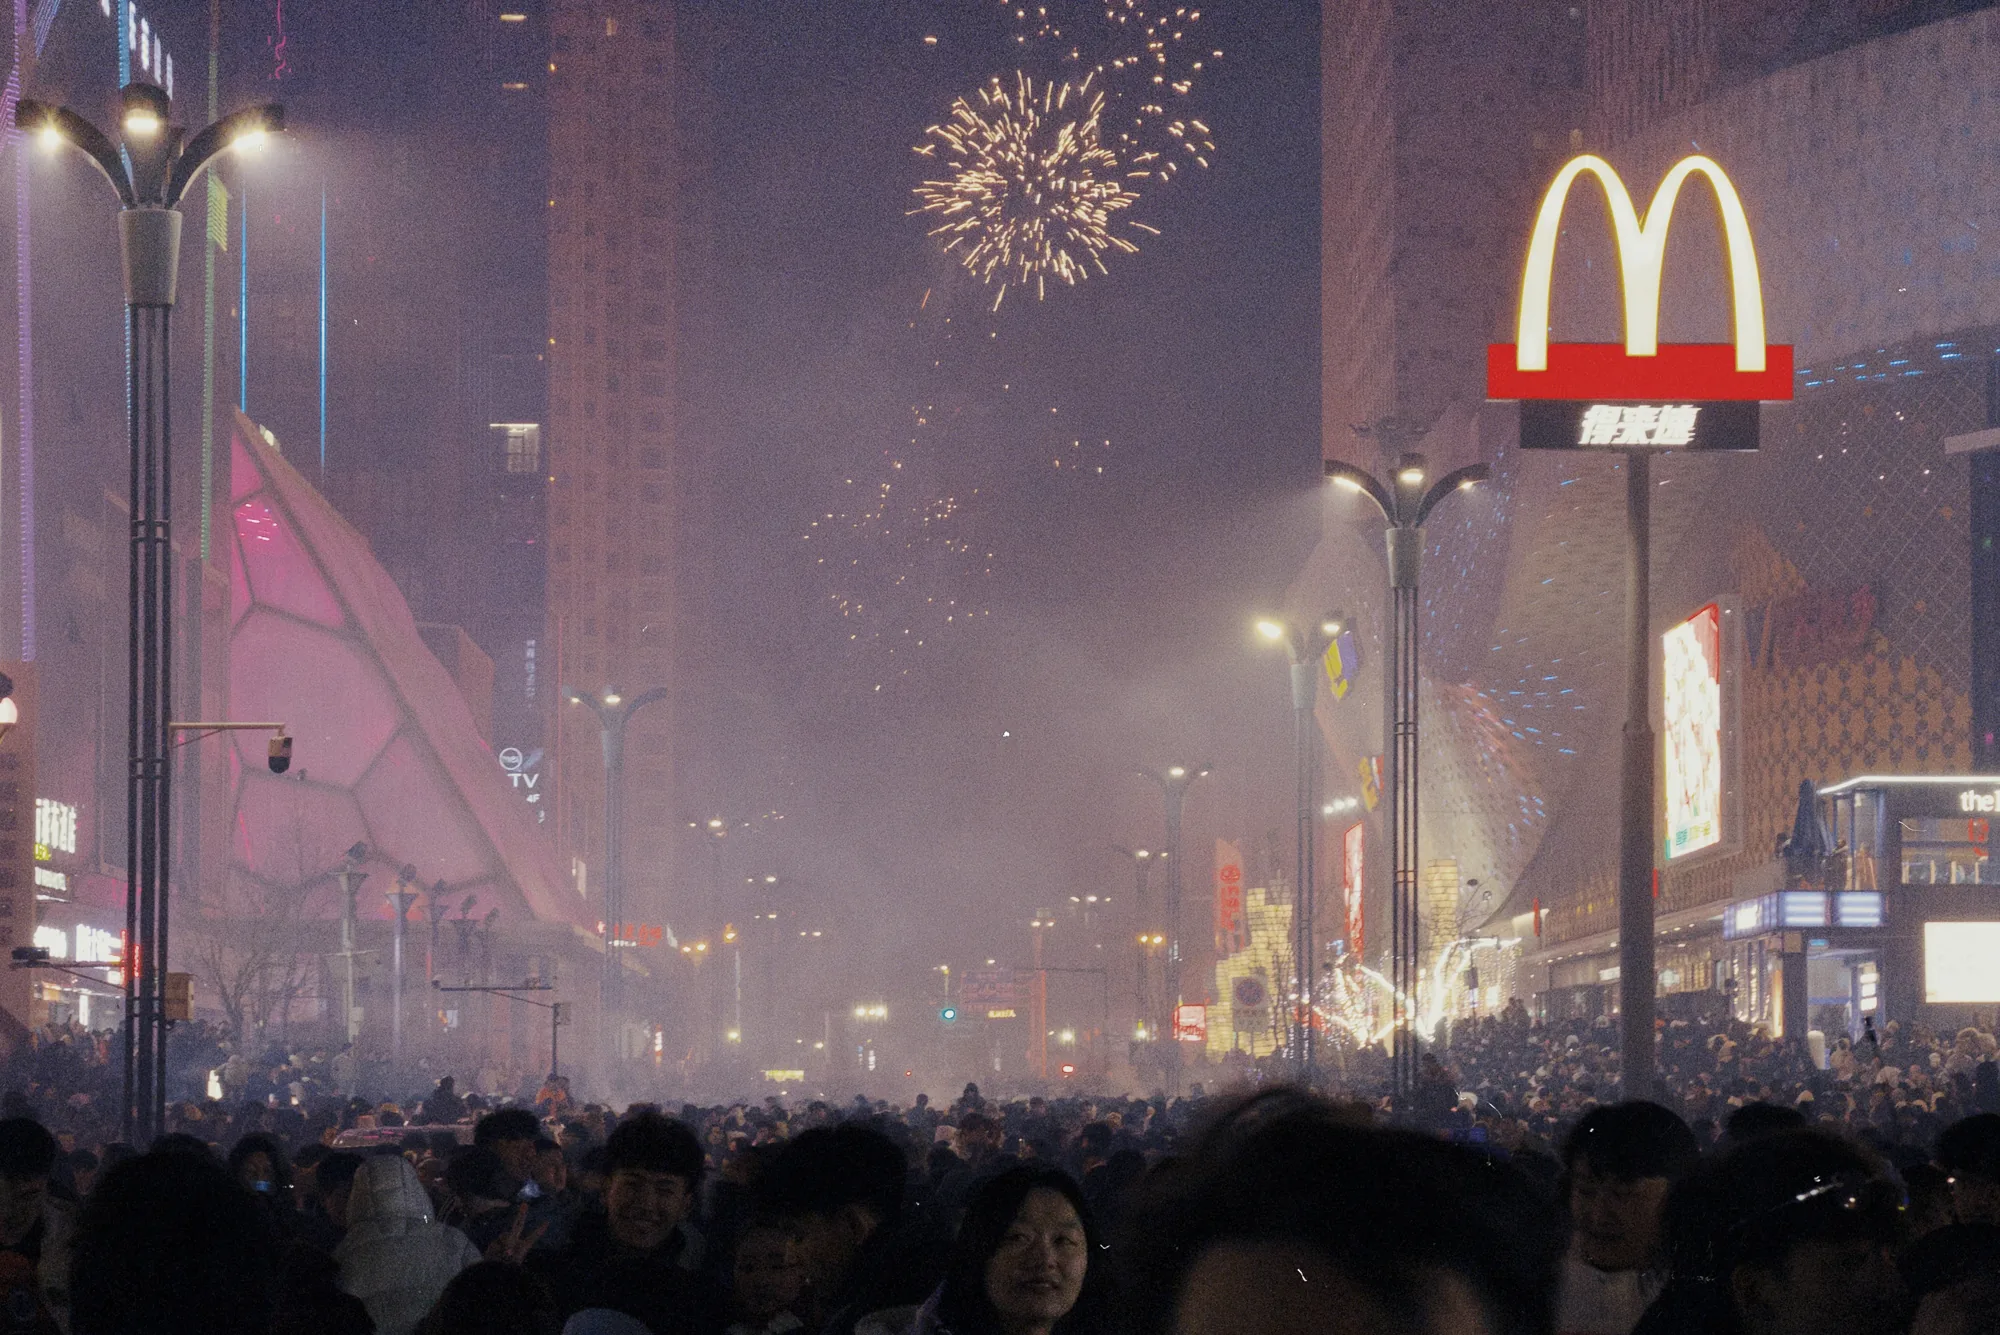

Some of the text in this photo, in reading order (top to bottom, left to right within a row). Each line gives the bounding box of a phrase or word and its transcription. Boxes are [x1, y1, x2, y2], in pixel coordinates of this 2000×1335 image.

[1578, 404, 1702, 445] 得来速
[507, 773, 539, 788] TV
[1960, 789, 2000, 813] the
